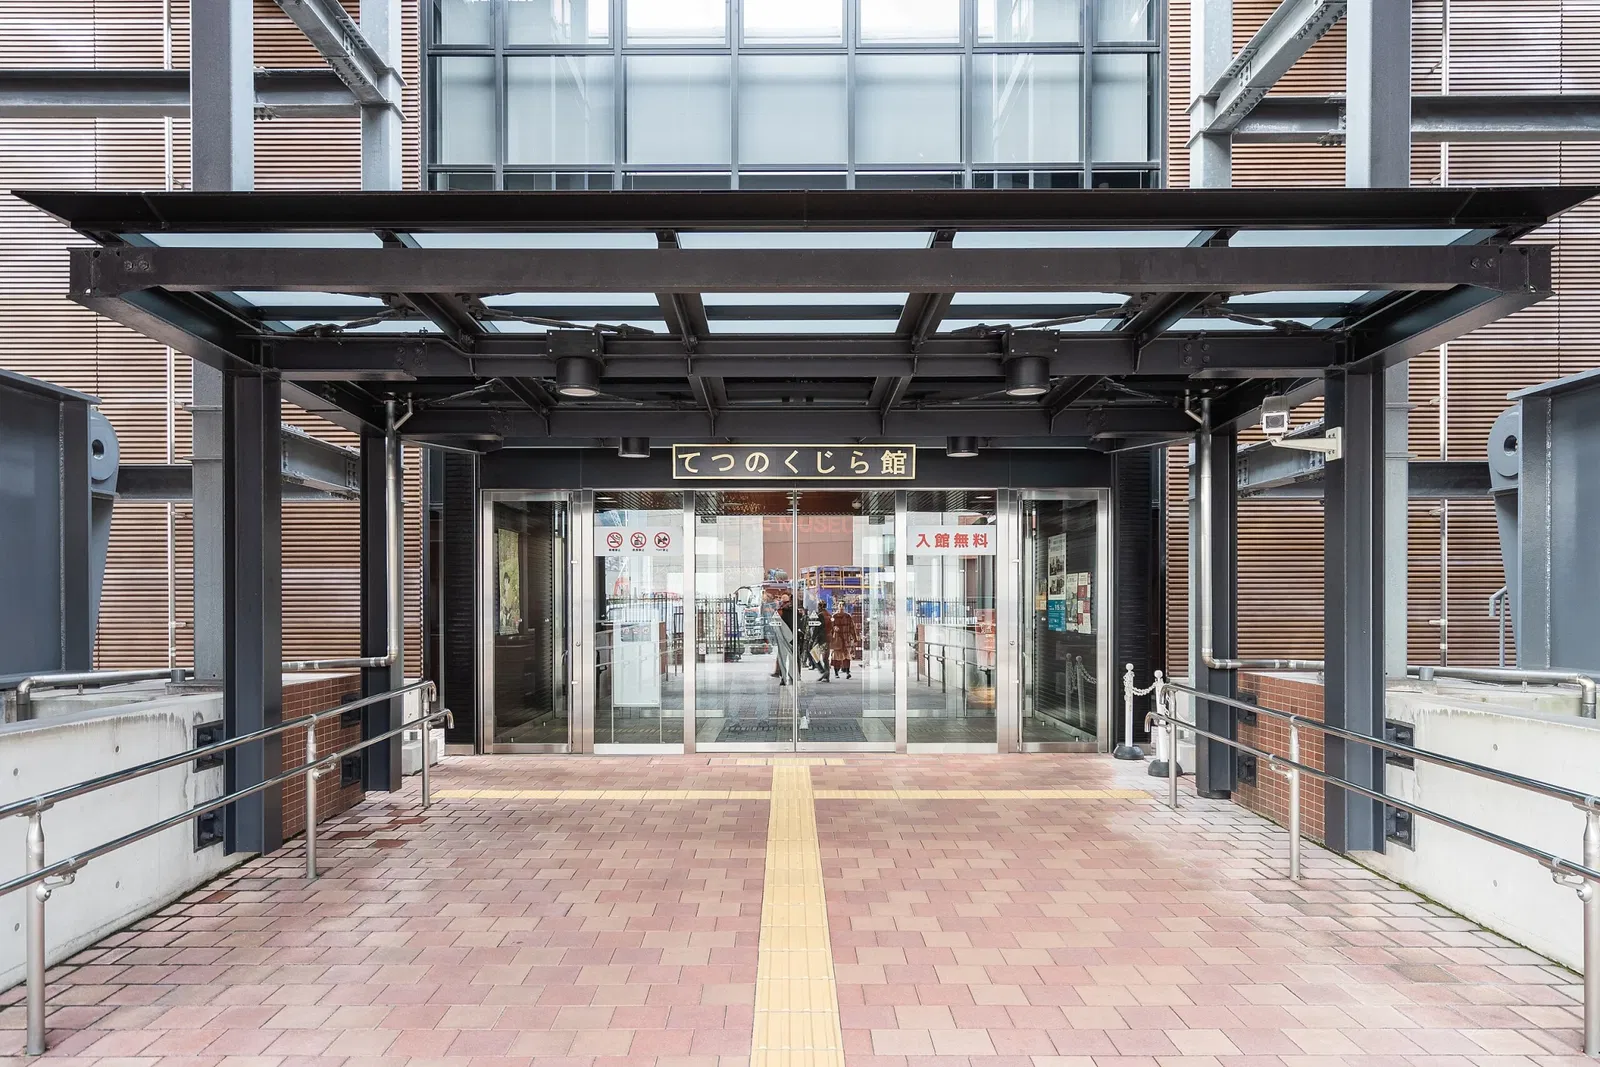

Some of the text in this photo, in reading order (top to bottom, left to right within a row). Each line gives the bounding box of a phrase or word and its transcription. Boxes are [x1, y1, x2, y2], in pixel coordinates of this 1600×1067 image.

[677, 449, 908, 475] てつのくじら館
[915, 532, 989, 548] 入館無料
